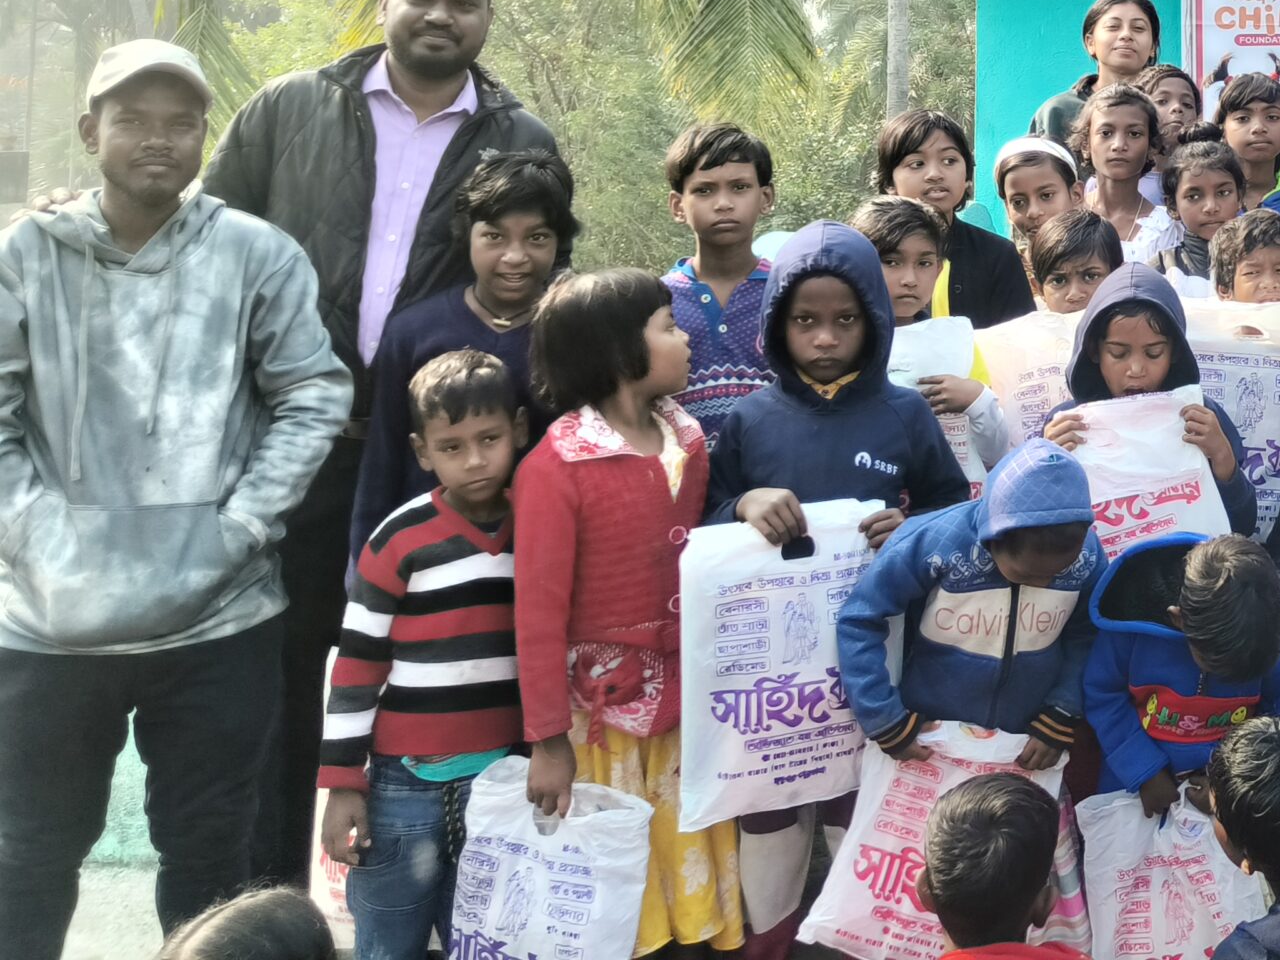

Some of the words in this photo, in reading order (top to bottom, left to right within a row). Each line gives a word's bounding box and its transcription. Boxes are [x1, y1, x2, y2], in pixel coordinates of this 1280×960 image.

[873, 459, 898, 475] SRBF
[717, 581, 753, 597] উৎসবে
[719, 600, 766, 616] বেনারসী
[718, 660, 767, 674] রেডিমেড
